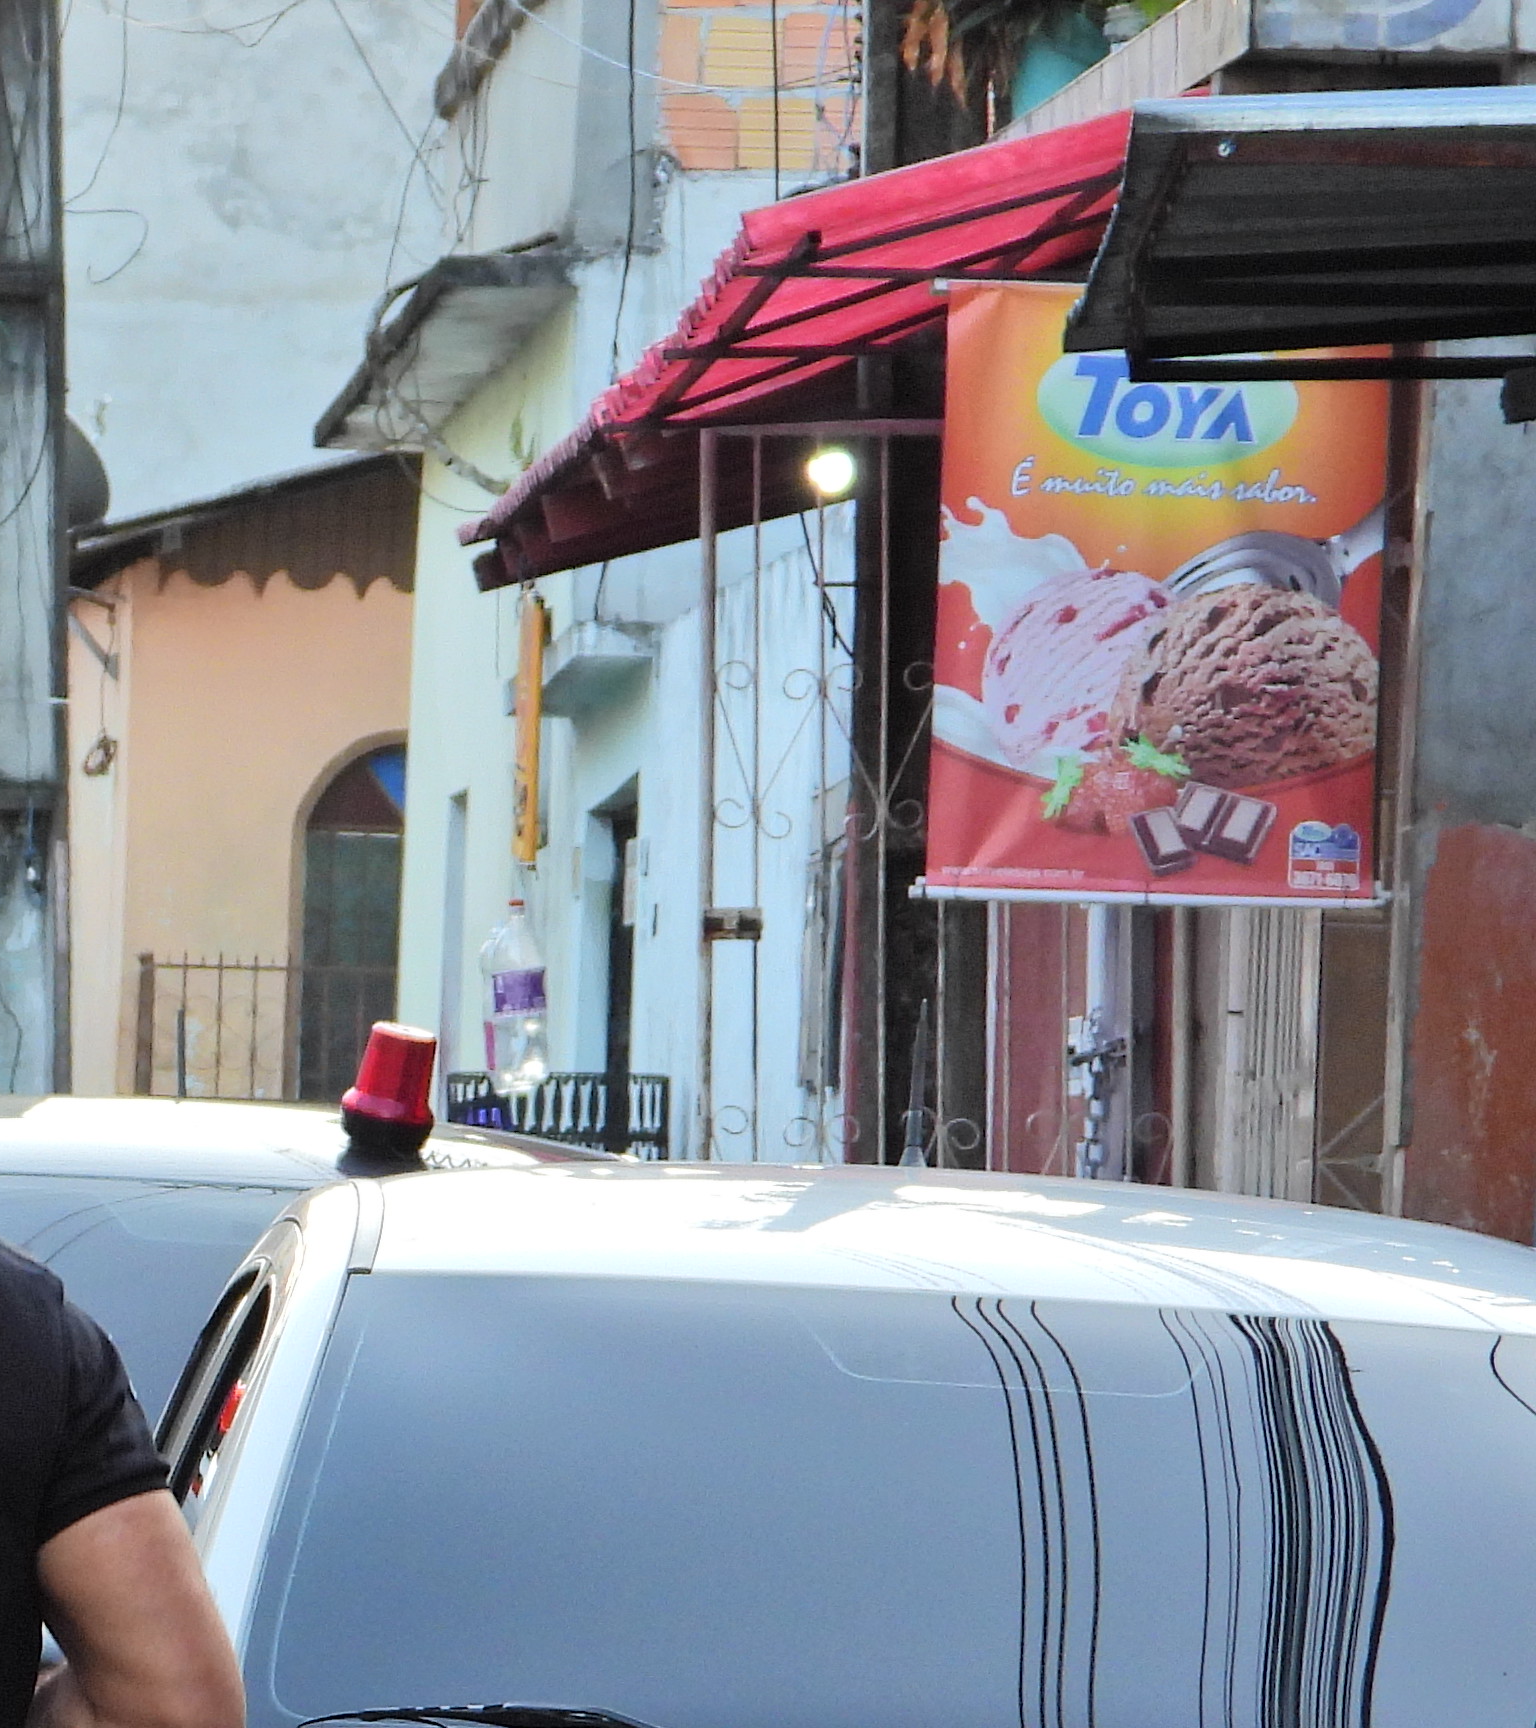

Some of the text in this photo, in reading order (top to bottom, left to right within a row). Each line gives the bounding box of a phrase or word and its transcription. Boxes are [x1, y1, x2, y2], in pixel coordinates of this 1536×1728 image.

[1075, 354, 1256, 442] TOYA
[1011, 456, 1317, 503] É muito mais sabor.
